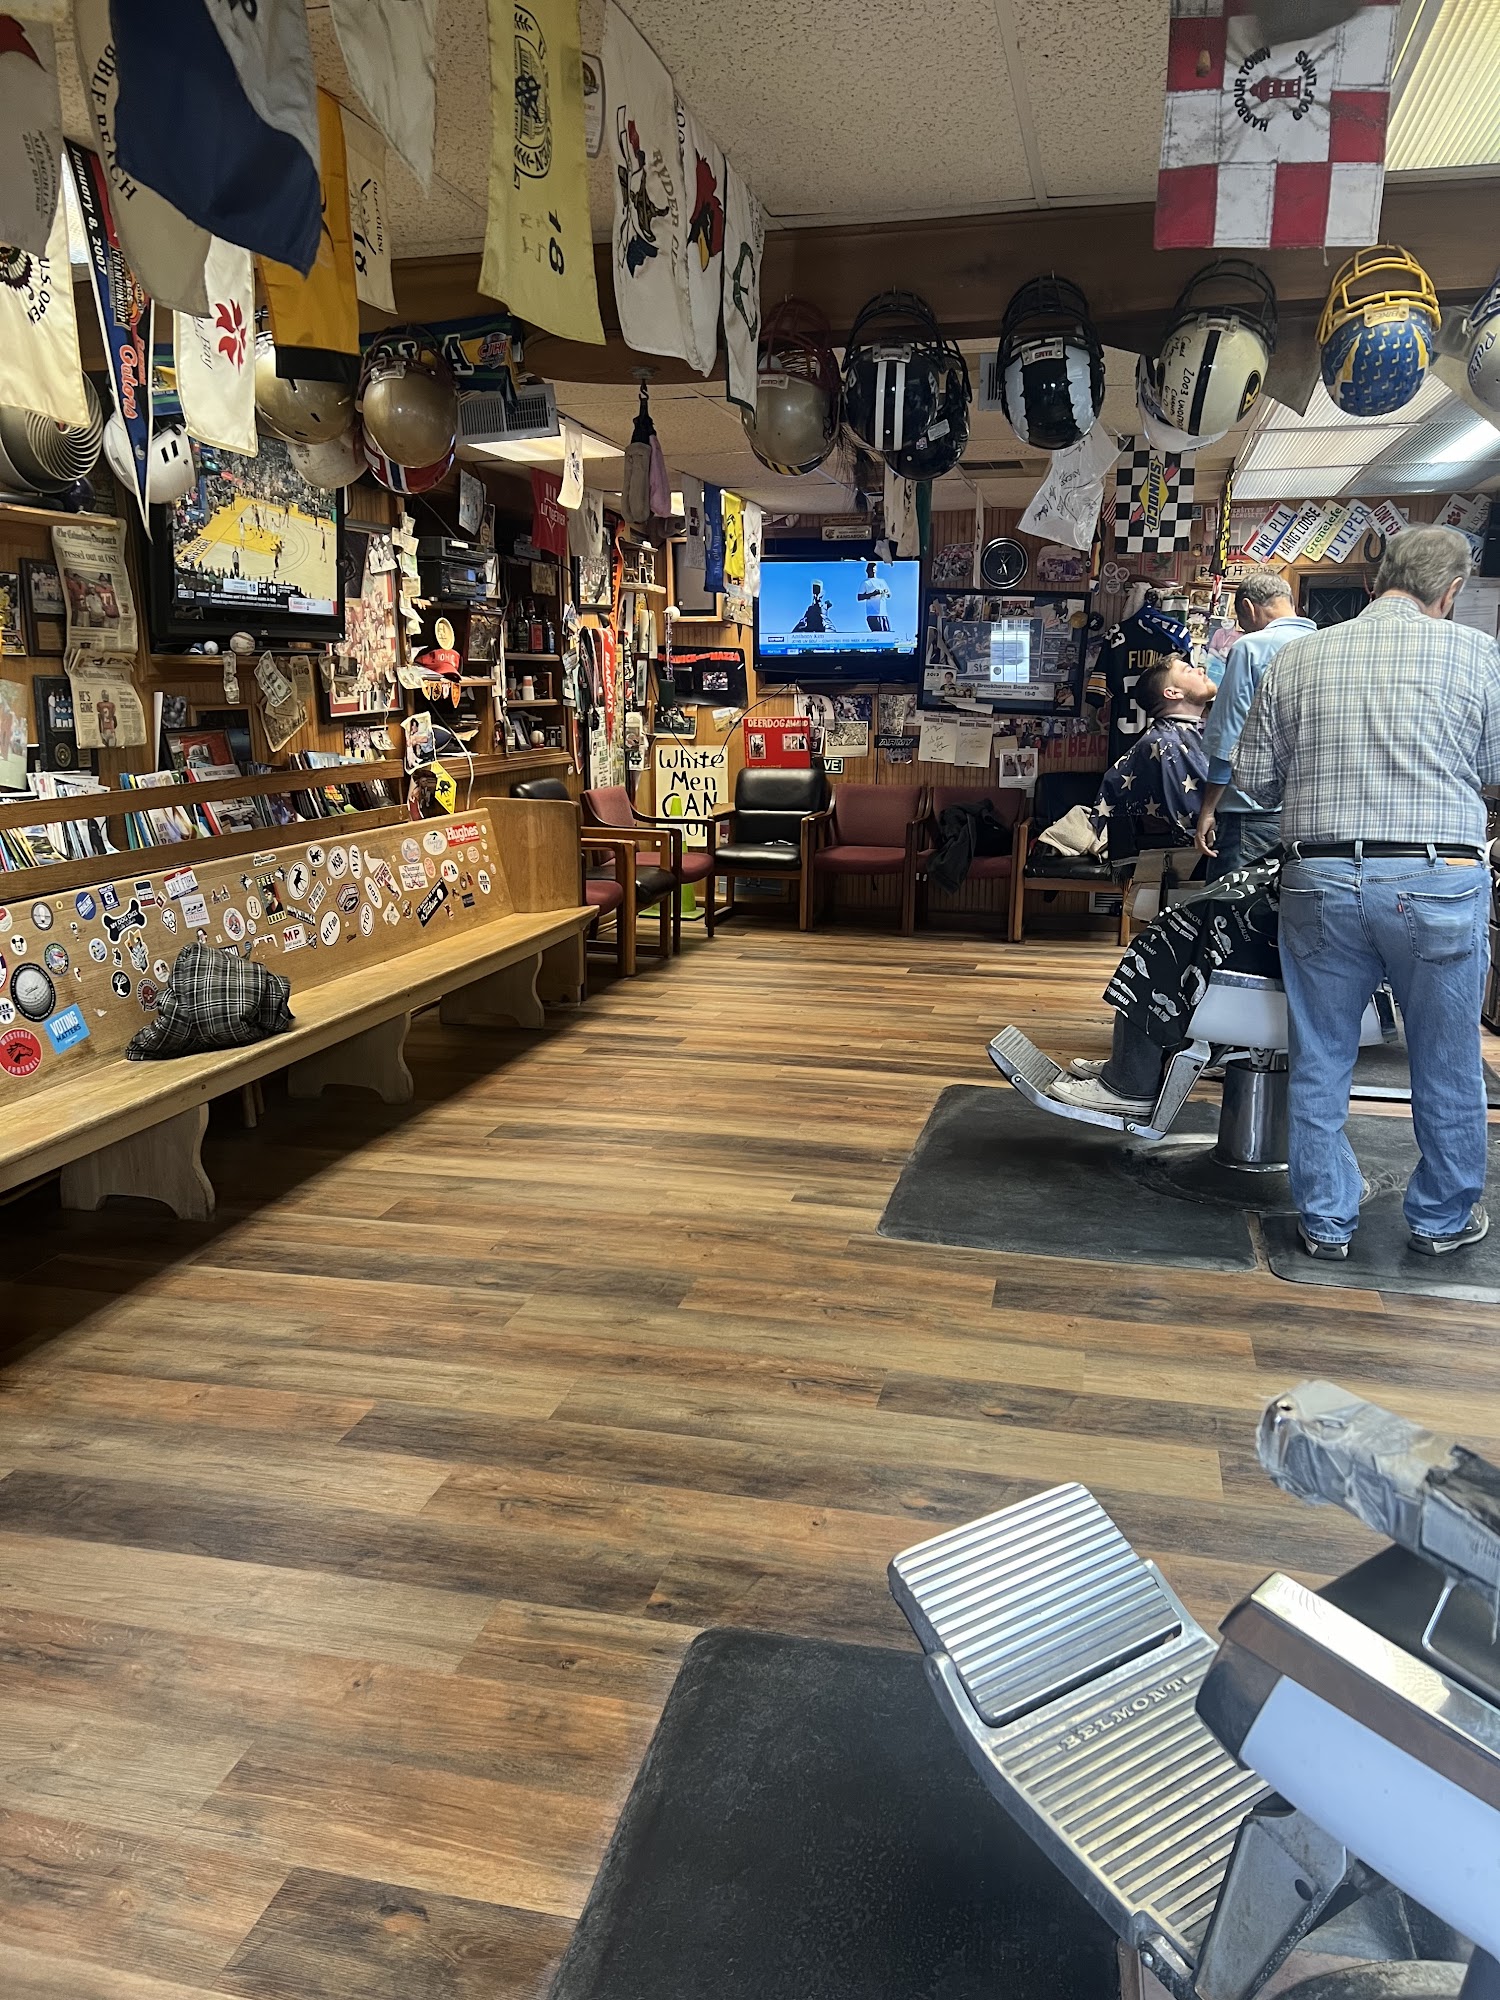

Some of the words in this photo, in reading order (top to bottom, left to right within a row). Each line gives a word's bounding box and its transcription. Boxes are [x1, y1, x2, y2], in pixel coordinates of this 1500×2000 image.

[1296, 51, 1317, 88] LINKS
[1234, 79, 1268, 132] HARBOUR
[1292, 90, 1316, 121] GOLF
[653, 150, 680, 229] RYDER
[71, 149, 94, 212] January
[92, 237, 108, 275] 2007
[547, 209, 565, 276] 18
[111, 250, 126, 323] CHAMPIONSHIP
[119, 345, 139, 420] Gators
[1181, 368, 1196, 396] 2003
[1147, 459, 1162, 528] SUNOCO
[1269, 510, 1292, 533] PLA
[1277, 531, 1301, 556] HANG
[1296, 506, 1322, 537] LOOSE
[1305, 508, 1343, 554] Grenelefe
[1336, 506, 1371, 545] VIPER
[604, 651, 615, 713] BEARCATS
[878, 738, 913, 746] ARMY
[659, 749, 726, 769] White
[671, 771, 717, 791] Men
[662, 791, 718, 818] CAN
[445, 824, 479, 842] Hughes
[256, 874, 275, 888] FREE
[1235, 910, 1252, 942] SURREALIST
[1, 1030, 32, 1047] WESTFALL
[49, 1011, 79, 1037] VOTING
[55, 1023, 83, 1043] MATTERS
[7, 1056, 40, 1074] FOOTBALL
[1061, 1677, 1184, 1752] BELMONT
